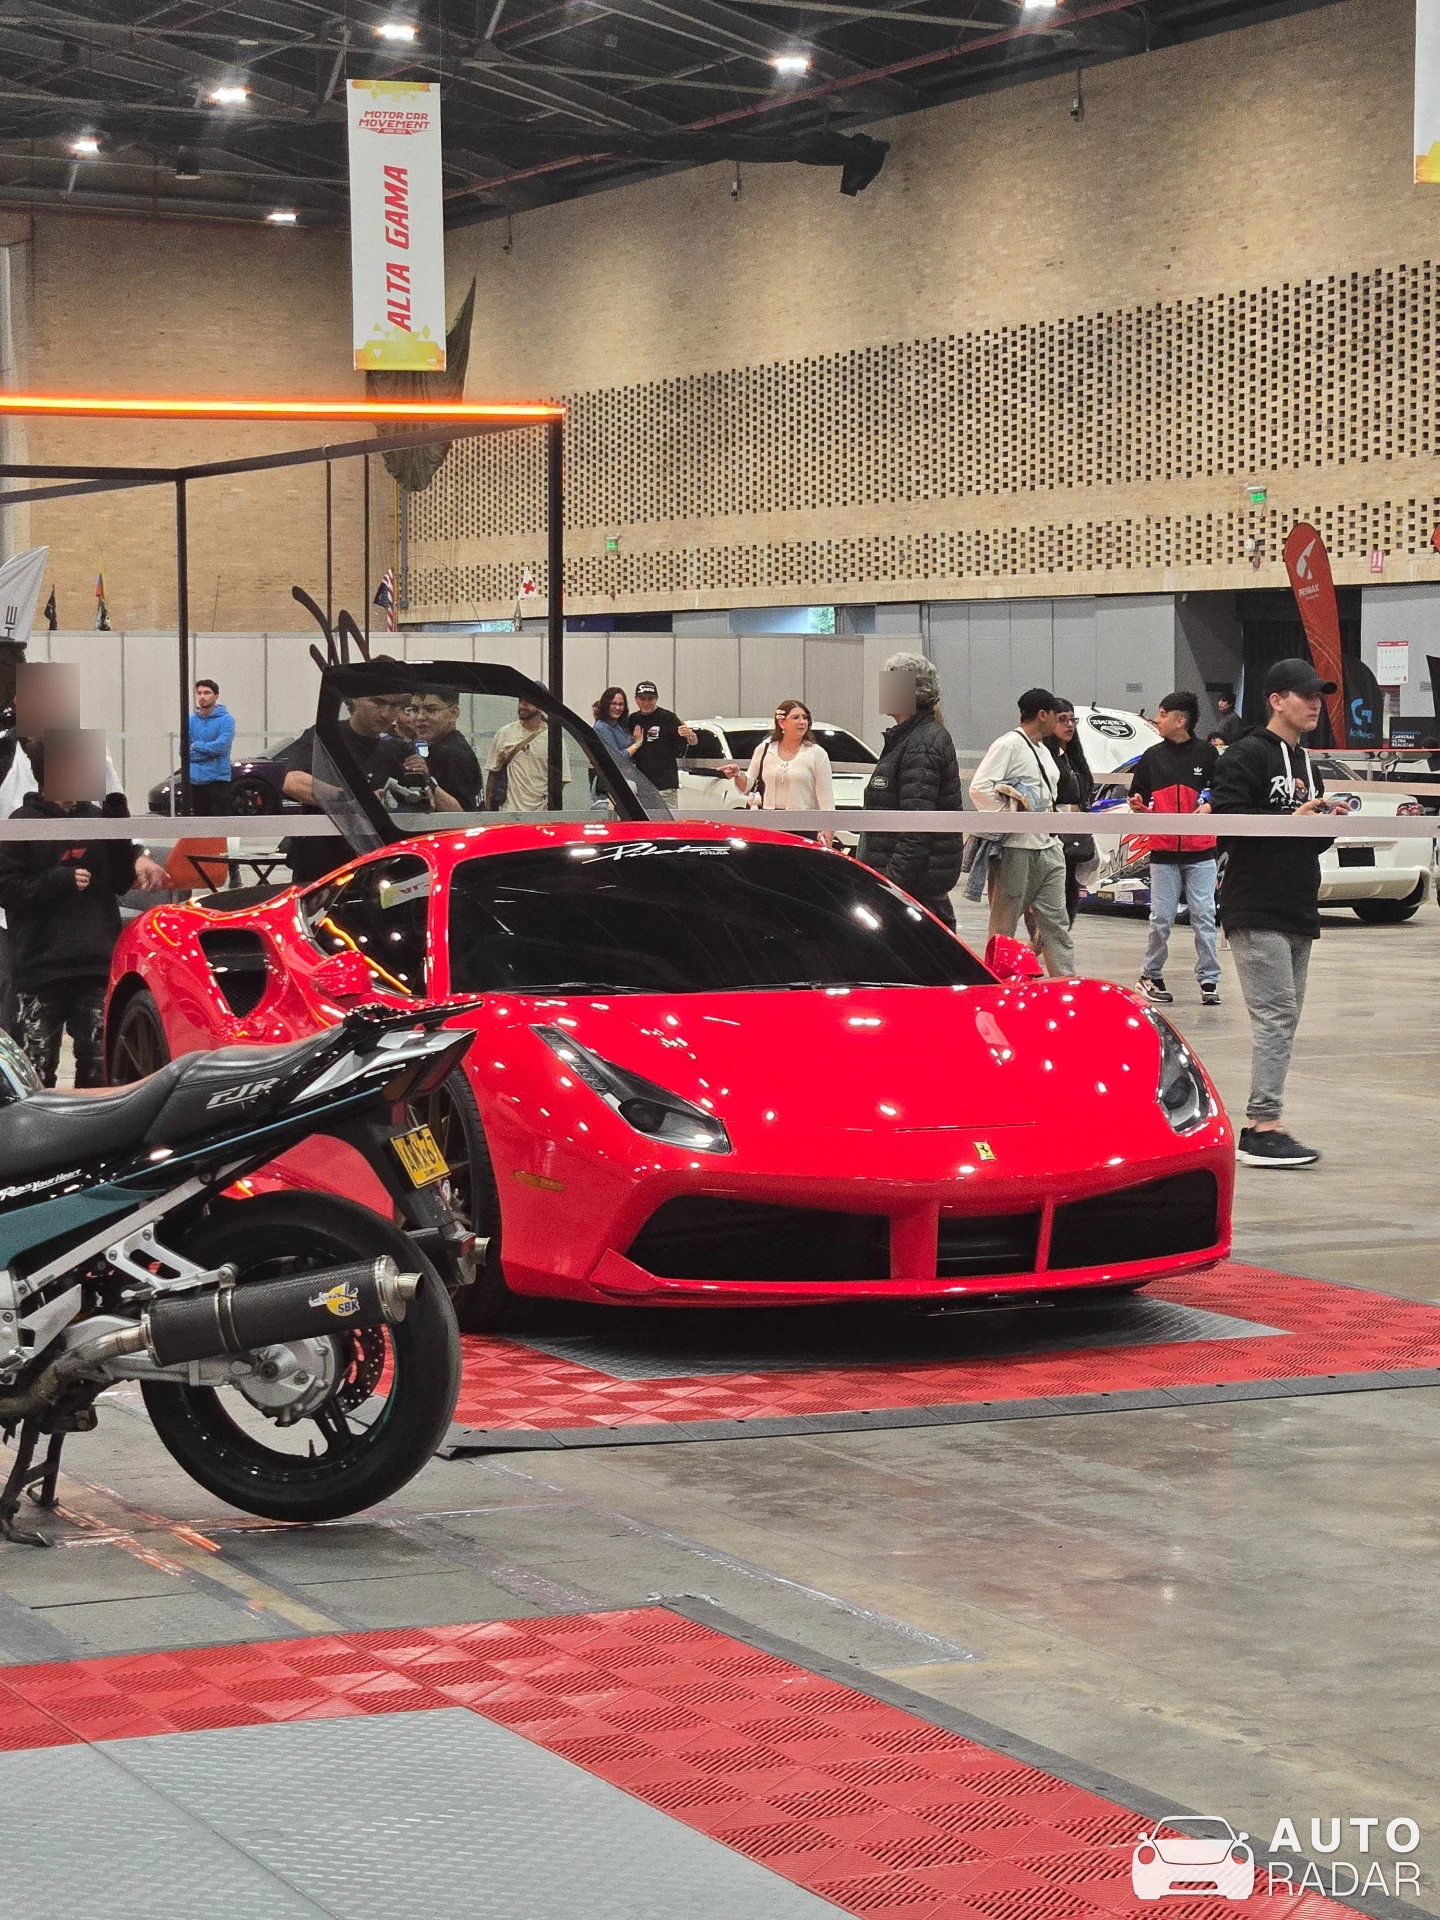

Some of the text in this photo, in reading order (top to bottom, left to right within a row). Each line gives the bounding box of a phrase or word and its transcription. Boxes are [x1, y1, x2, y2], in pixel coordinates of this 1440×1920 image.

[364, 110, 428, 120] MOTOR CAR
[358, 118, 430, 129] MOVEMENT
[383, 165, 412, 333] ALTA GAMA
[338, 1300, 359, 1314] SBK
